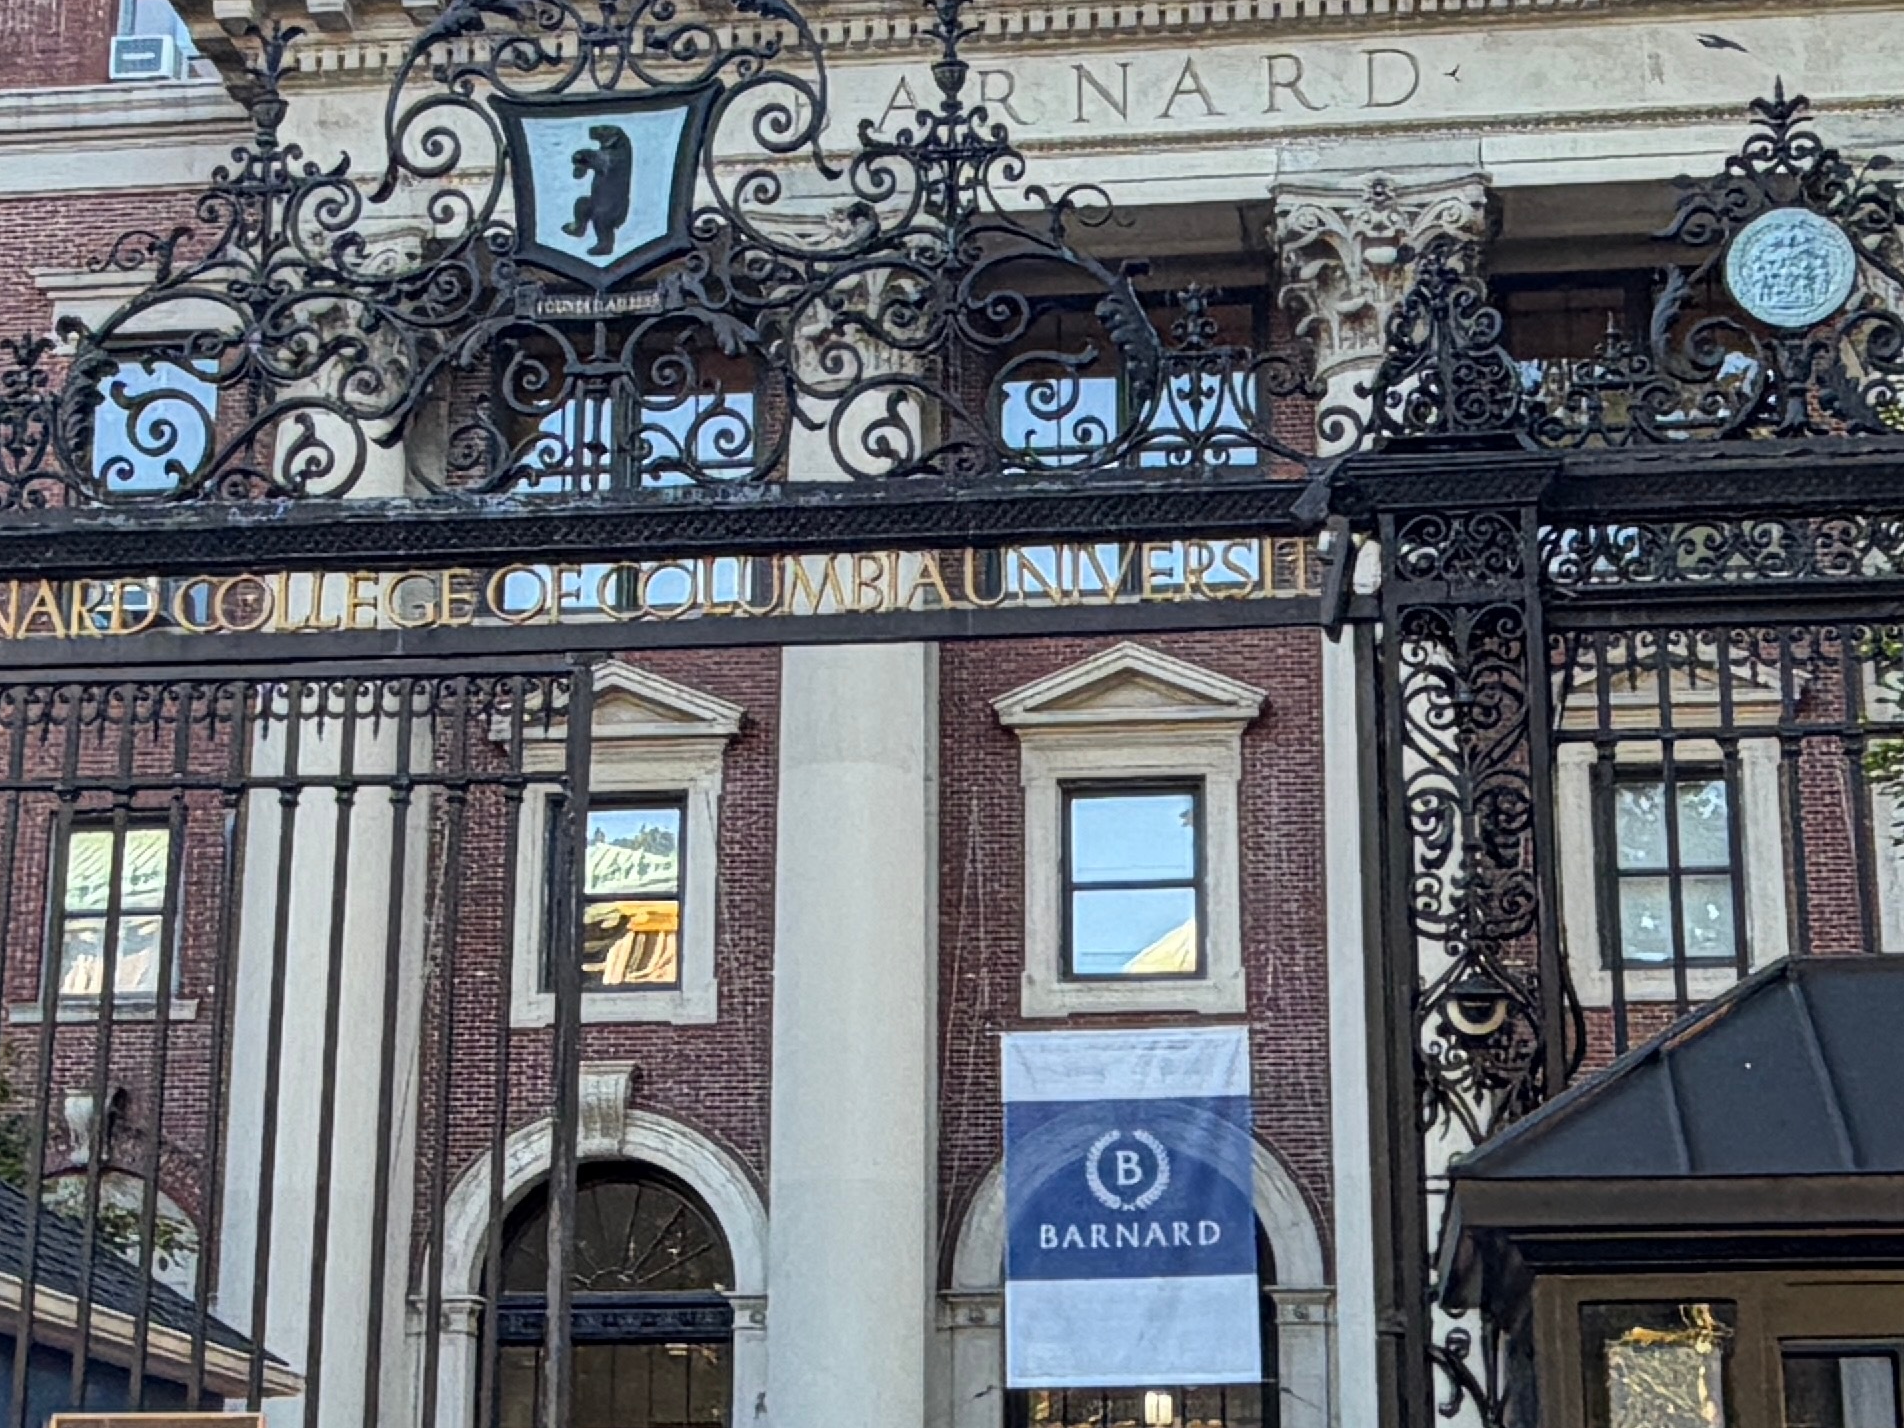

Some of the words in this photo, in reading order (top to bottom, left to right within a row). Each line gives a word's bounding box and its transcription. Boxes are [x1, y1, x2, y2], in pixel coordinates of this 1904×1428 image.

[174, 566, 475, 634] COLLEGE
[486, 562, 583, 625] OF
[597, 551, 956, 622] COLUMBIA
[964, 535, 1370, 606] UNIVERSIT
[1115, 1150, 1143, 1186] B
[1039, 1220, 1222, 1250] BARNARD
